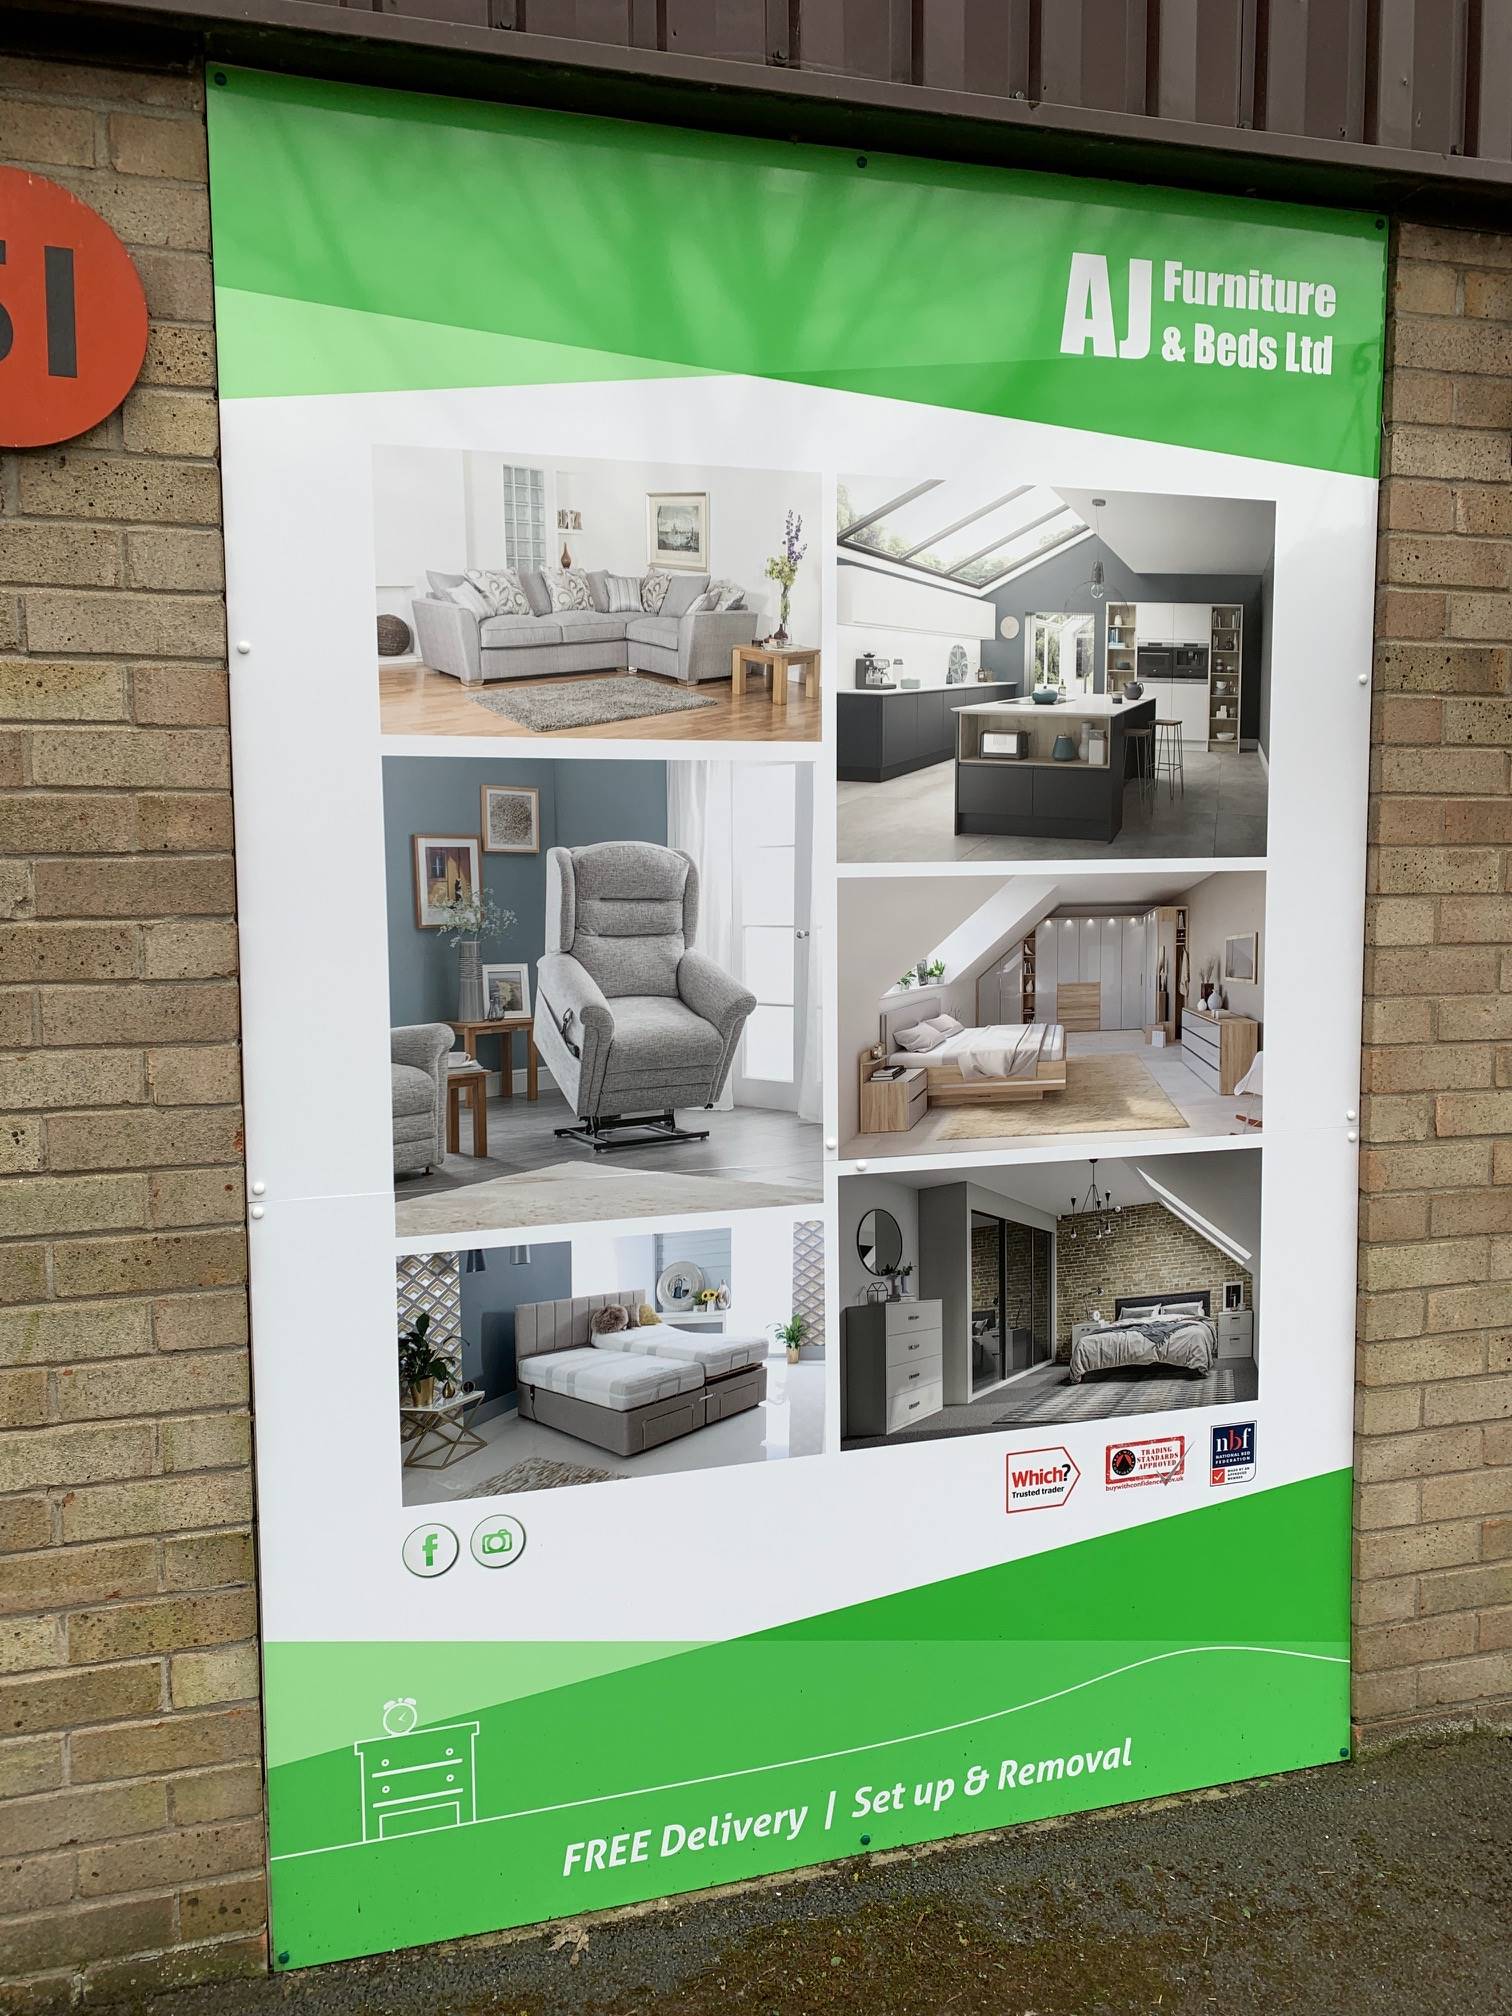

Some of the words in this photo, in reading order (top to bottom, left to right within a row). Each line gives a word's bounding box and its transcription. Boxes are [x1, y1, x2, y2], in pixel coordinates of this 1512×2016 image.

[1164, 260, 1337, 318] Furniture
[0, 240, 78, 378] 1
[1060, 251, 1153, 360] AJ
[1161, 326, 1186, 363] &
[1194, 322, 1278, 371] Beds
[1285, 331, 1333, 376] Ltd
[1141, 1446, 1172, 1456] TRADING
[1216, 1427, 1252, 1453] nbf
[1137, 1453, 1178, 1465] STANDARDS
[1139, 1460, 1176, 1472] APPROVED
[1011, 1463, 1072, 1488] Which?
[1106, 1476, 1184, 1492] buywithconfidenceov.uk
[1011, 1488, 1040, 1499] Trusted
[1041, 1485, 1065, 1495] trader
[562, 1829, 653, 1877] FREE
[659, 1805, 808, 1859] Delivery
[851, 1786, 906, 1819] Set
[913, 1776, 955, 1812] up
[963, 1765, 990, 1796] &
[997, 1737, 1133, 1791] Removal
